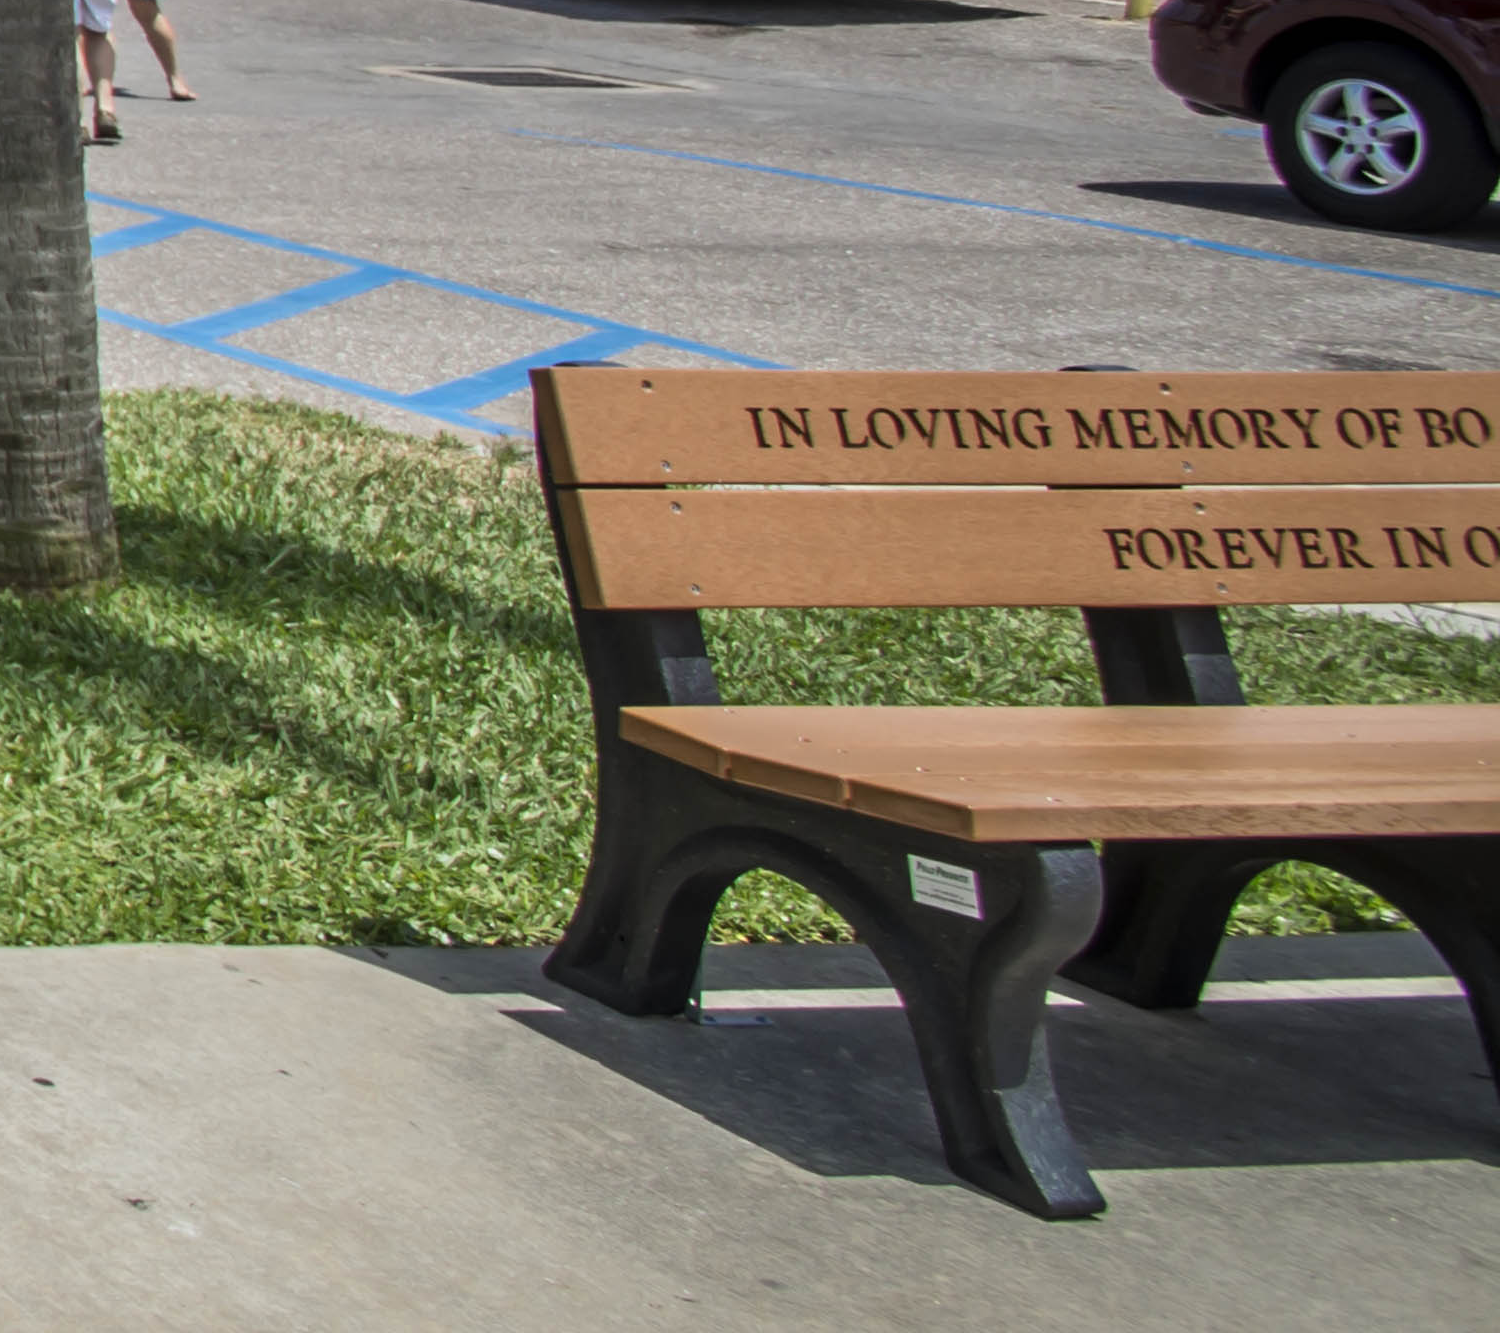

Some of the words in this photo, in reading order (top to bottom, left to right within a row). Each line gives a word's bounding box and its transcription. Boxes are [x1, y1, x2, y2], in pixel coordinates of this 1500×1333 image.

[745, 406, 815, 450] IN
[828, 406, 1052, 450] LOVING
[1065, 407, 1322, 450] MEMORY
[1335, 406, 1404, 450] OF
[1102, 526, 1375, 571] FOREVER
[1381, 526, 1453, 570] IN
